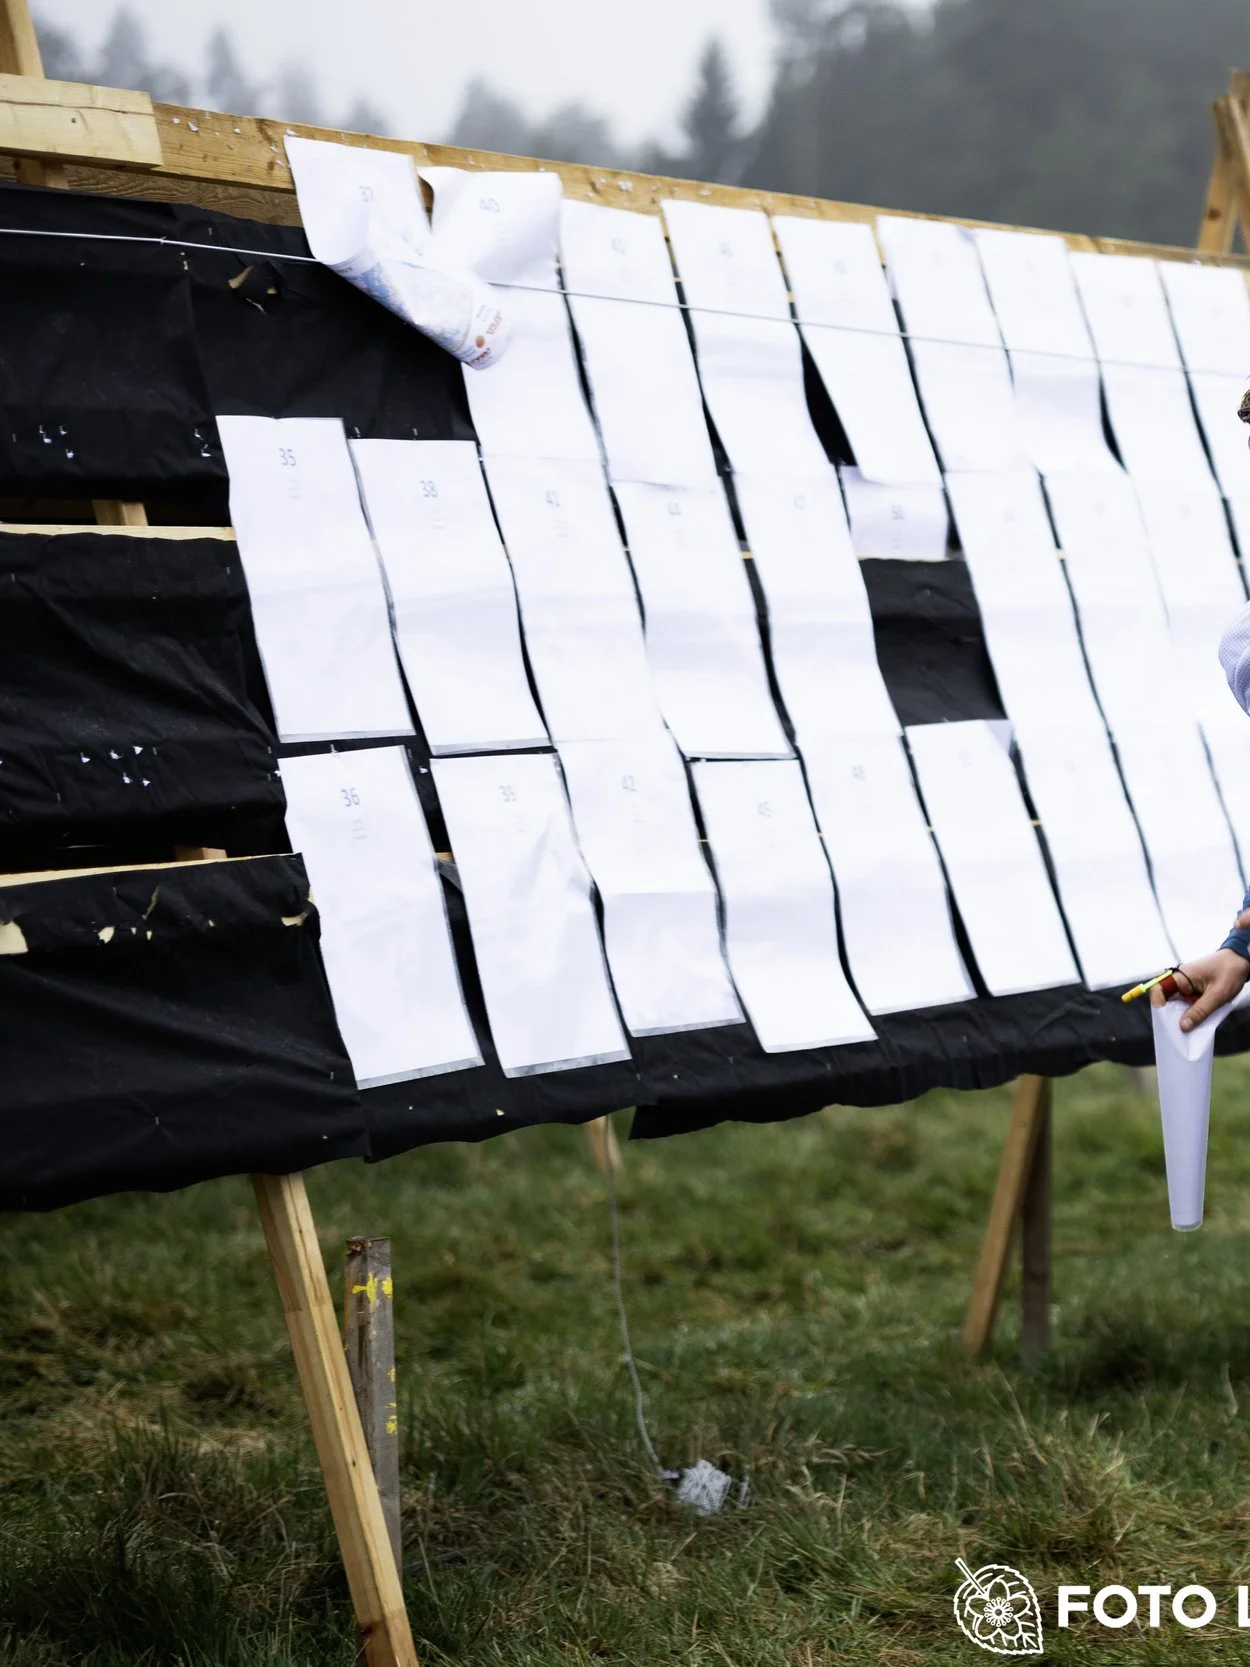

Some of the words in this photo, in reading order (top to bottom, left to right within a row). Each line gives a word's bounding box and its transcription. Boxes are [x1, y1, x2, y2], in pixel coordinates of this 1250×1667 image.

[278, 447, 297, 466] 35
[420, 480, 439, 498] 38
[340, 787, 361, 807] 36
